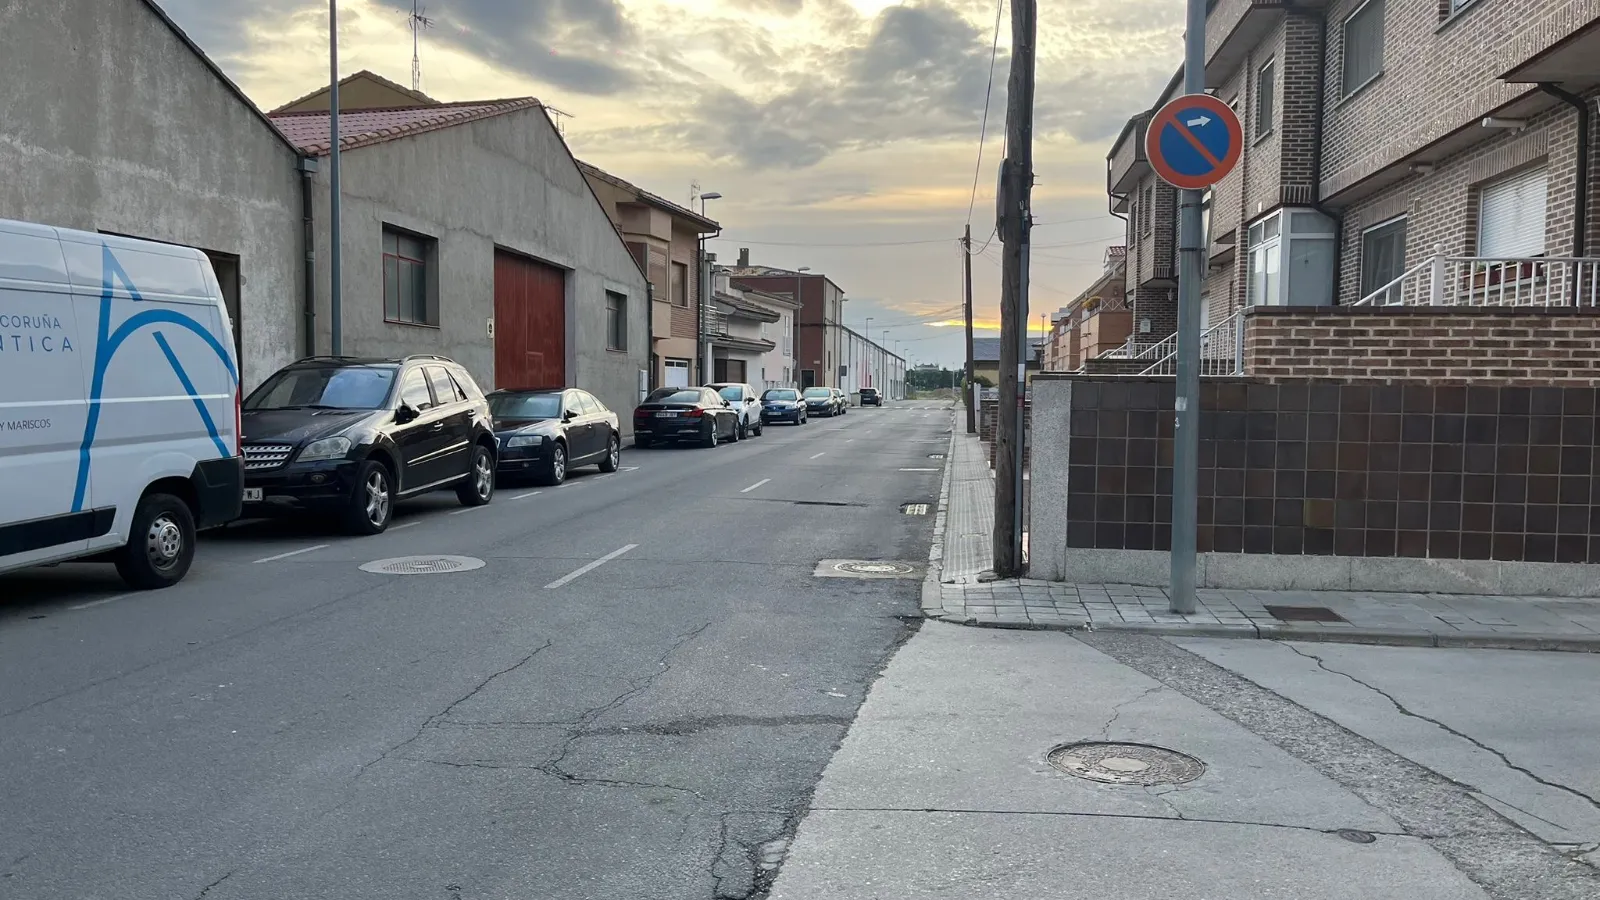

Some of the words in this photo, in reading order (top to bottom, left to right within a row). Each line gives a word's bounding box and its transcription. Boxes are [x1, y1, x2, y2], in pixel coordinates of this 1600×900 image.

[0, 314, 62, 329] CORUÑA
[7, 419, 51, 431] MARISCOS
[242, 489, 260, 500] WJ
